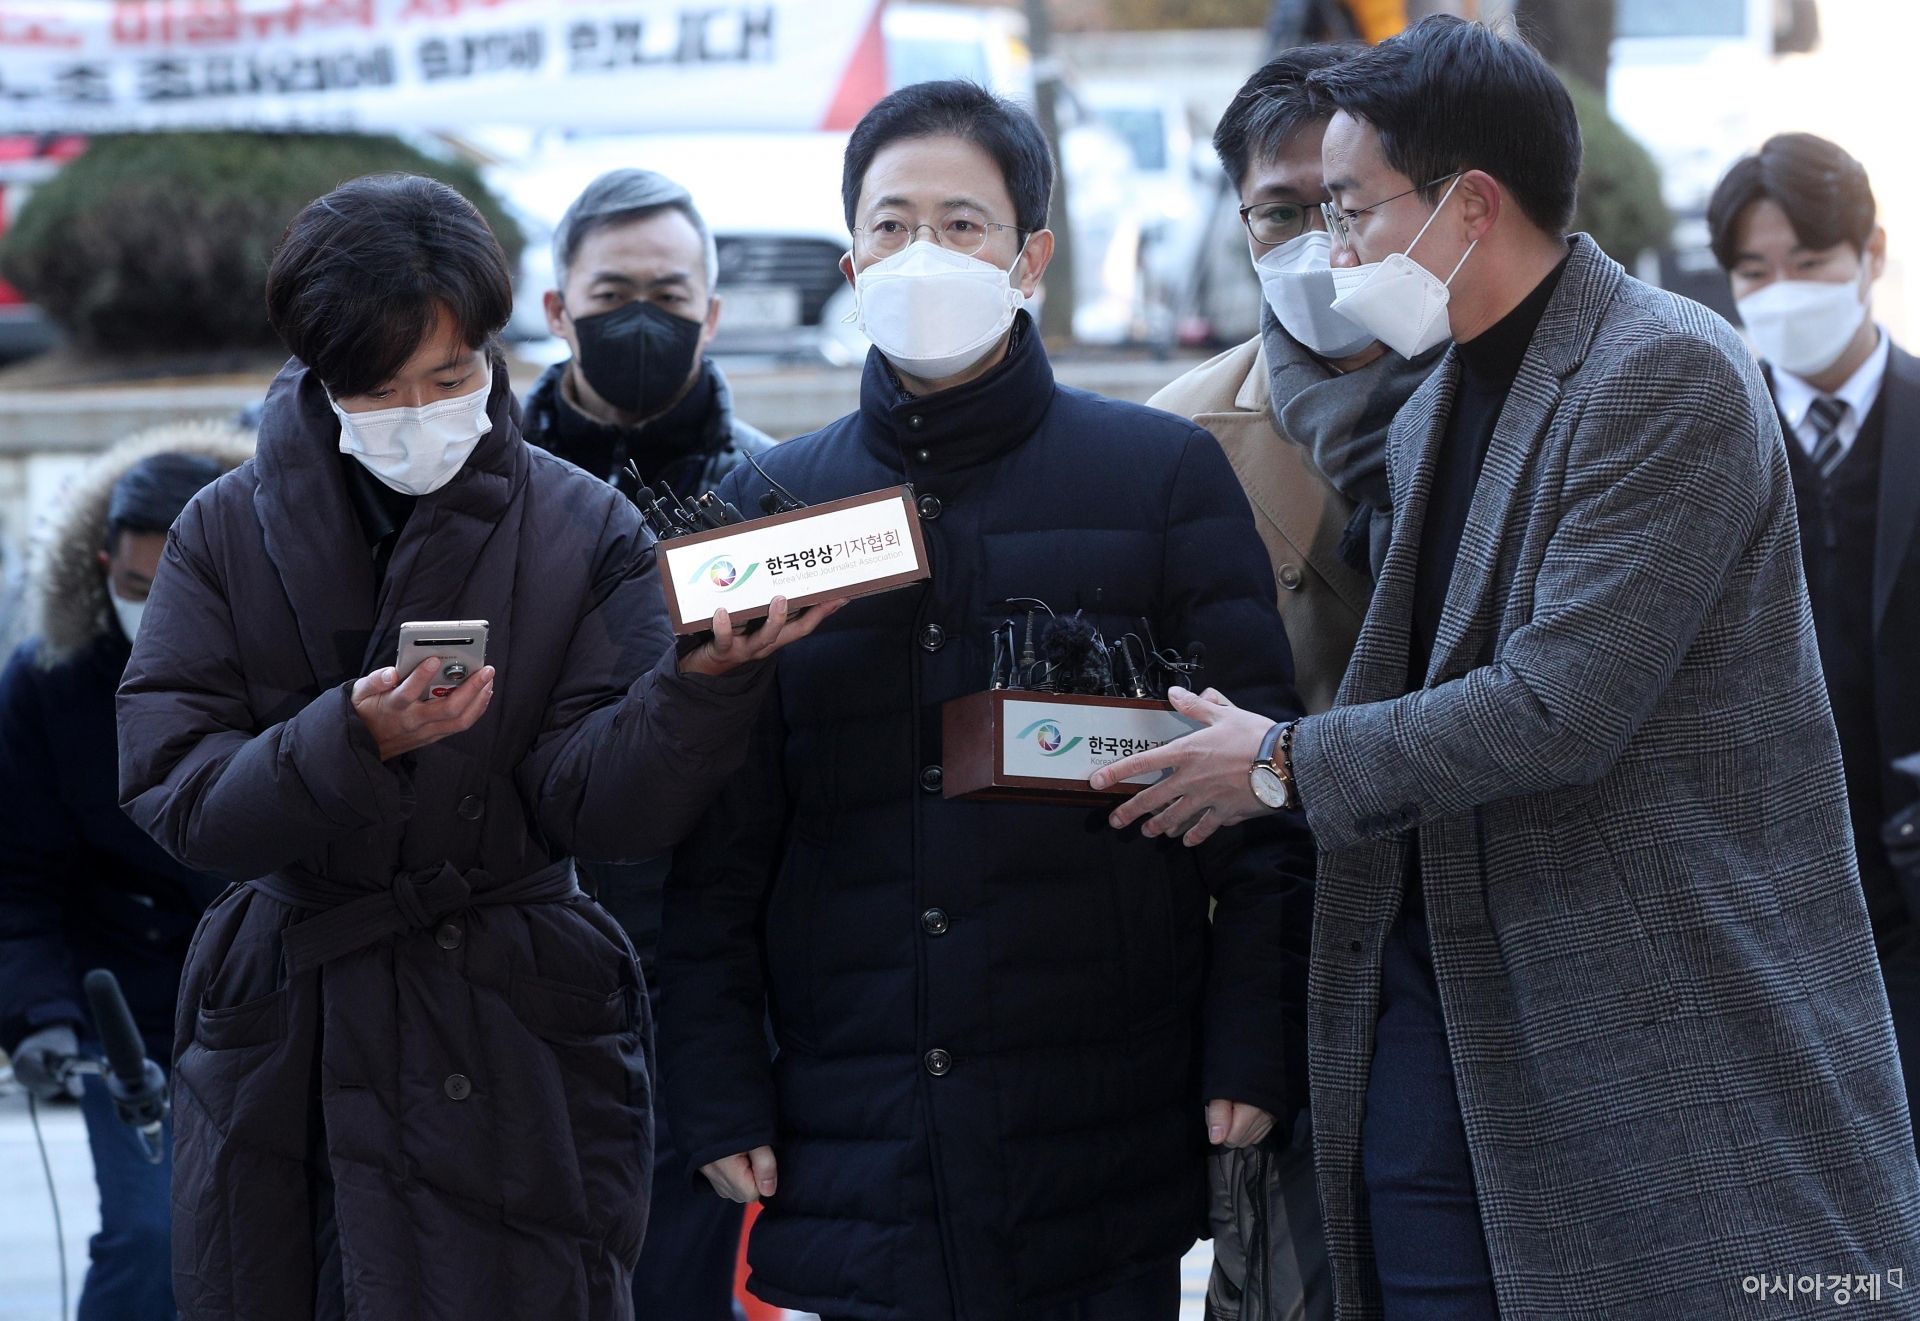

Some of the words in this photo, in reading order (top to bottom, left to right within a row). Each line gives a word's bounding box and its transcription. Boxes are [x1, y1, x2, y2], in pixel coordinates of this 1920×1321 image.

[765, 529, 901, 576] 한국영상기자협회
[772, 574, 796, 586] Korea
[797, 569, 819, 581] Video
[820, 561, 857, 577] Journalist
[859, 550, 904, 567] Association
[1090, 757, 1112, 766] Korea
